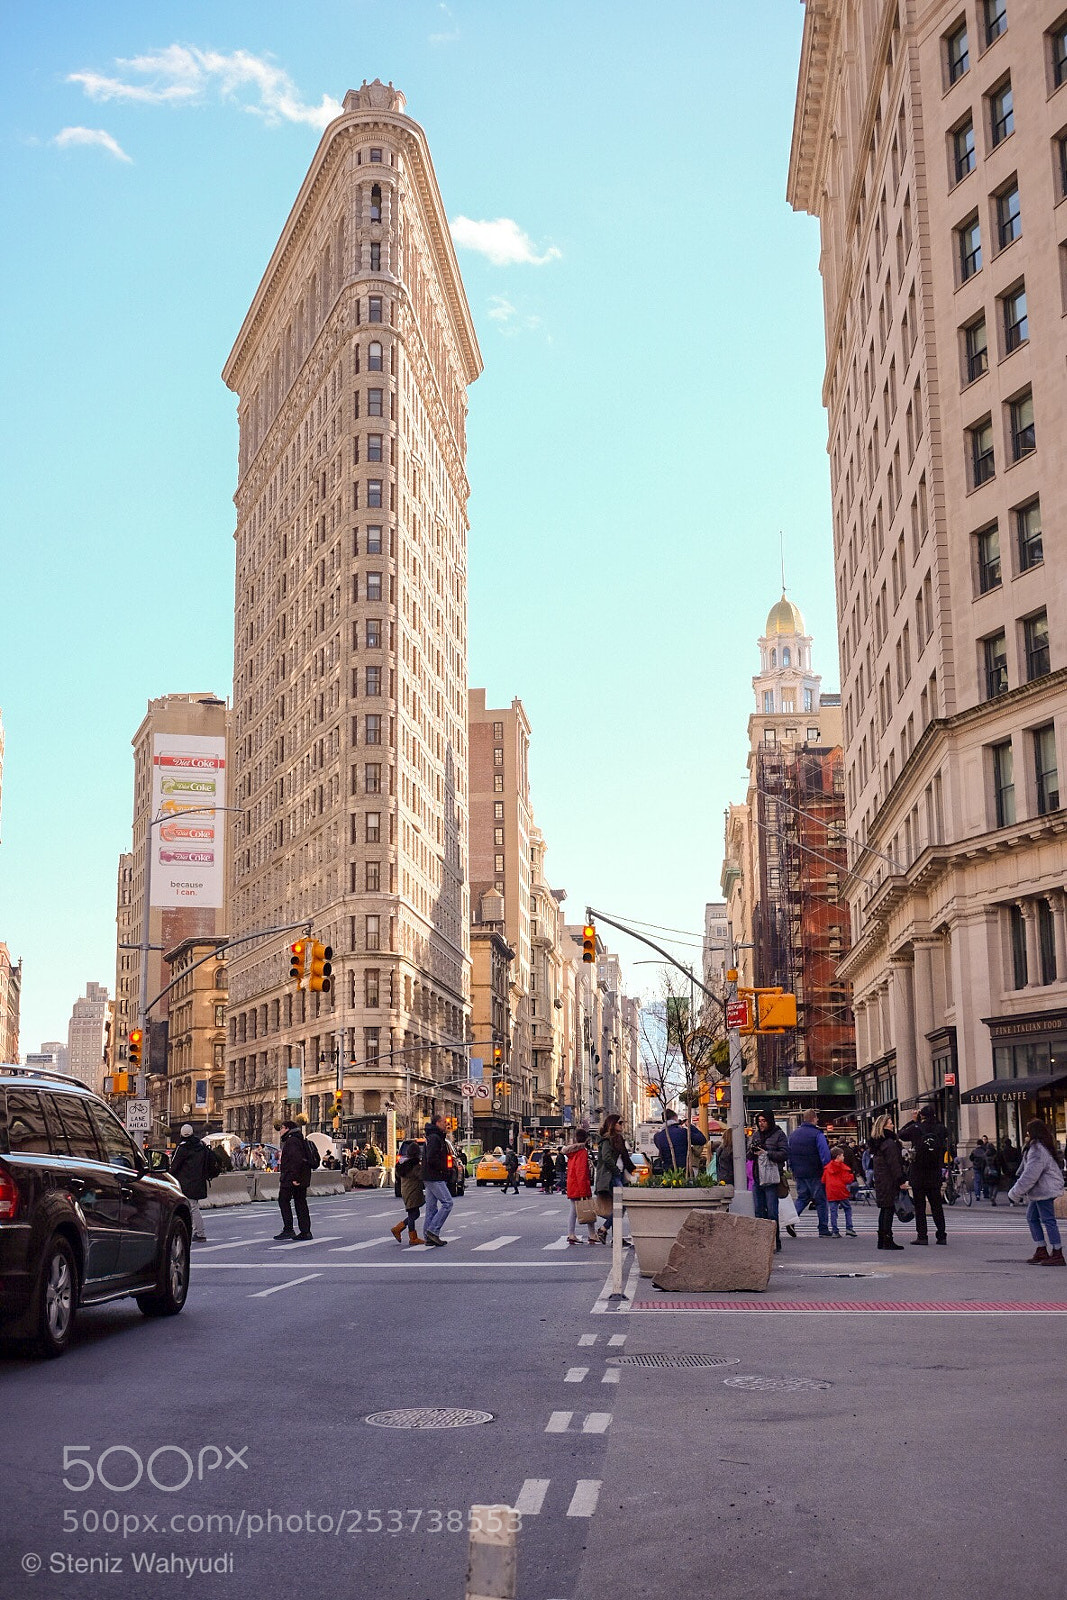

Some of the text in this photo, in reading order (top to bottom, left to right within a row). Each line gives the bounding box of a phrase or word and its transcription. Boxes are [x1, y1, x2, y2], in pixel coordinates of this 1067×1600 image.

[173, 758, 215, 768] Diet Coke
[190, 782, 212, 792] Coke
[189, 829, 211, 838] Coke
[188, 853, 211, 861] Coke
[170, 881, 204, 889] because
[995, 1020, 1062, 1035] FINE ITALIAN FOOD
[970, 1094, 998, 1103] EATALY
